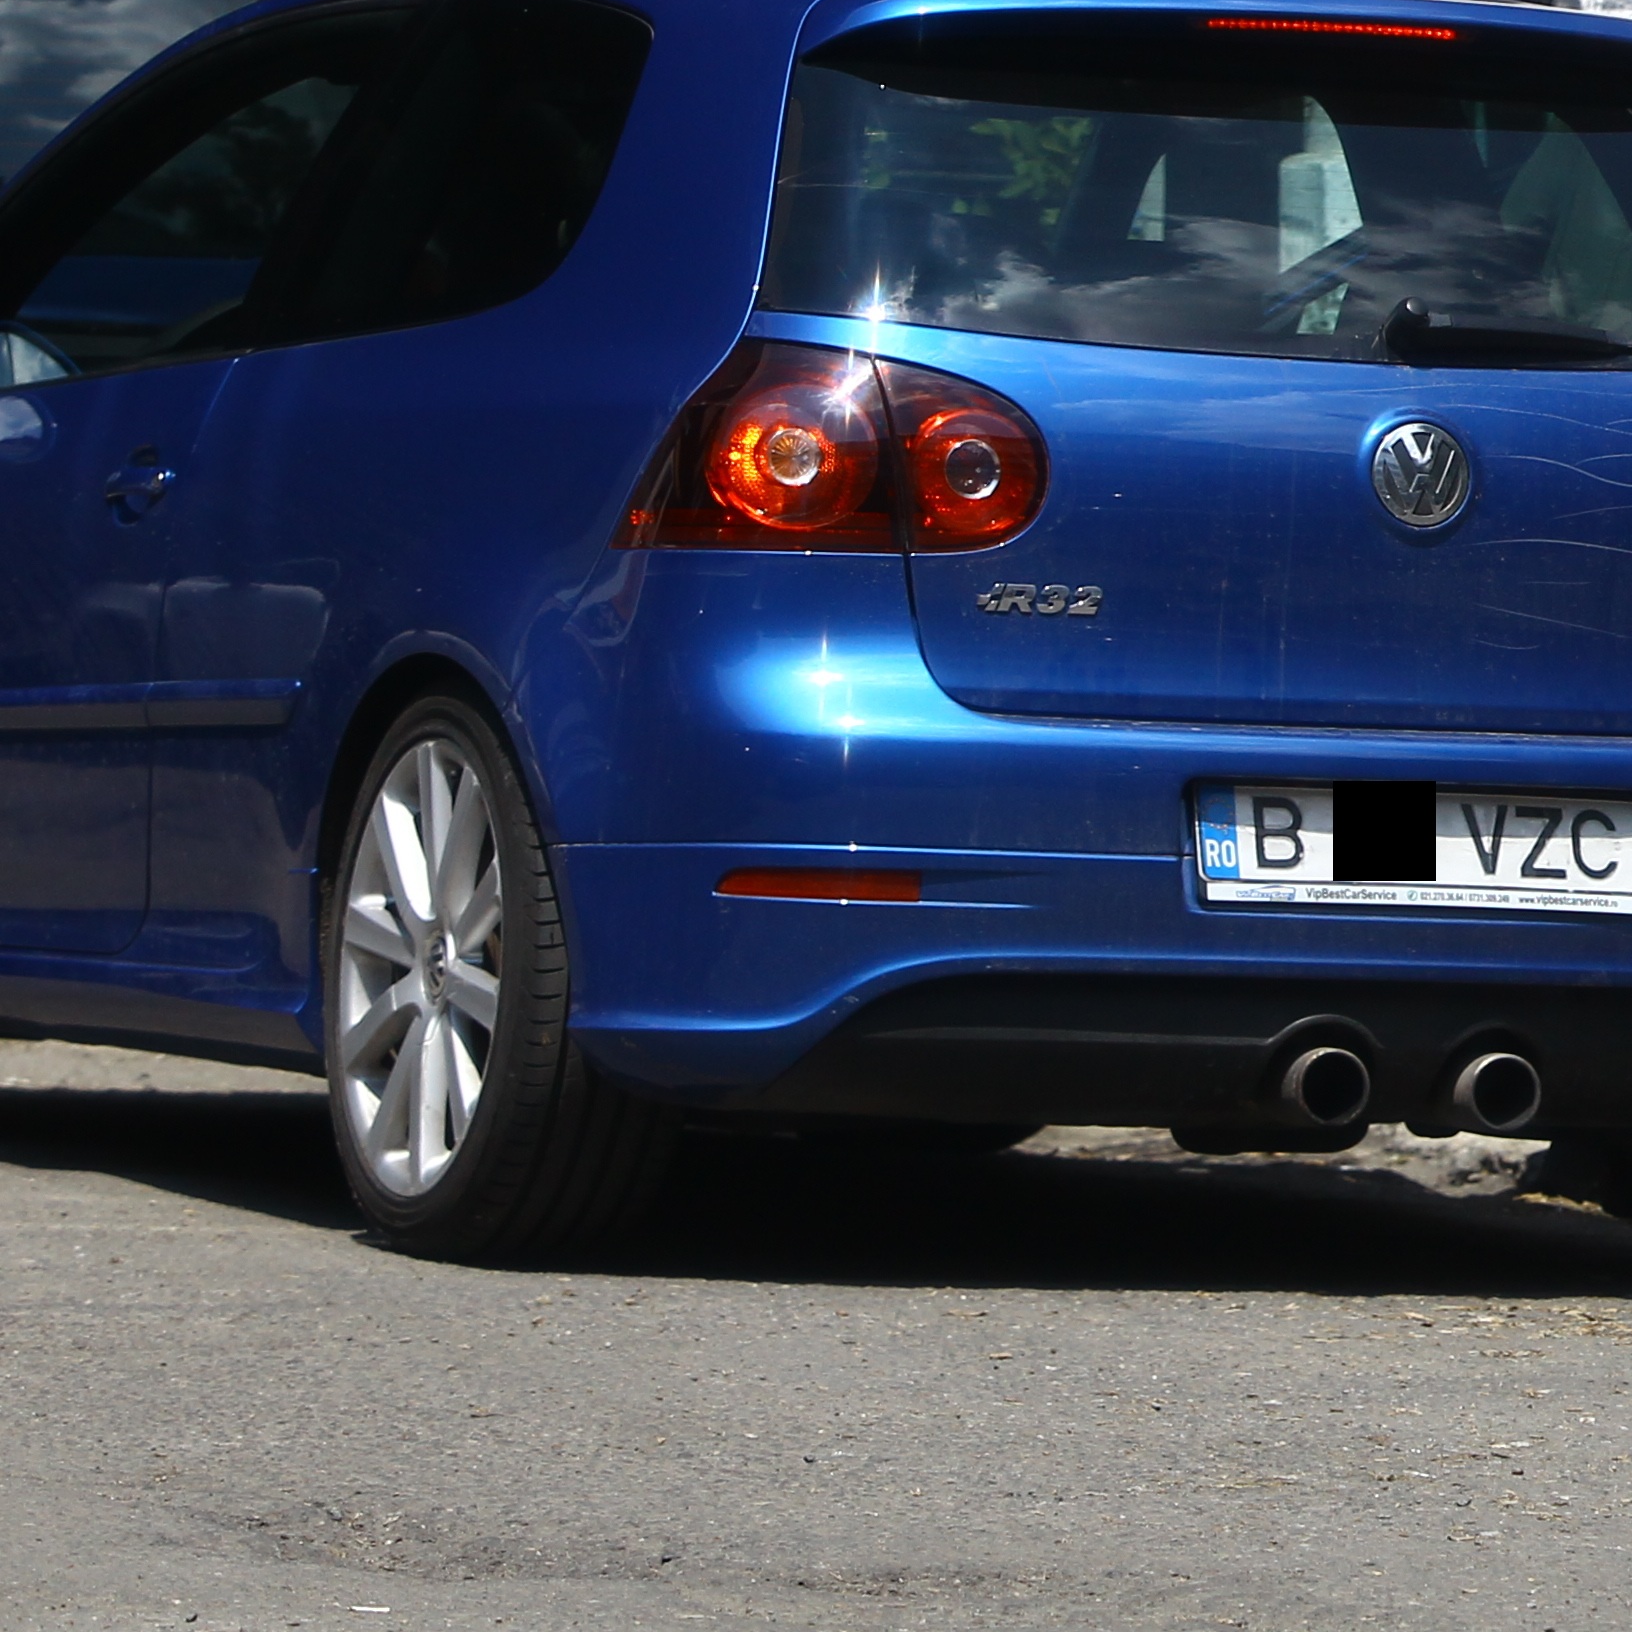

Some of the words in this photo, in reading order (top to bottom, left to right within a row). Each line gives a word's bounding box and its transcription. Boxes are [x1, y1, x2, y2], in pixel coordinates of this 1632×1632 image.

[1205, 839, 1237, 870] RO
[1253, 796, 1305, 871] B
[1461, 803, 1618, 880] VZC
[1305, 886, 1398, 902] VipBestCarService
